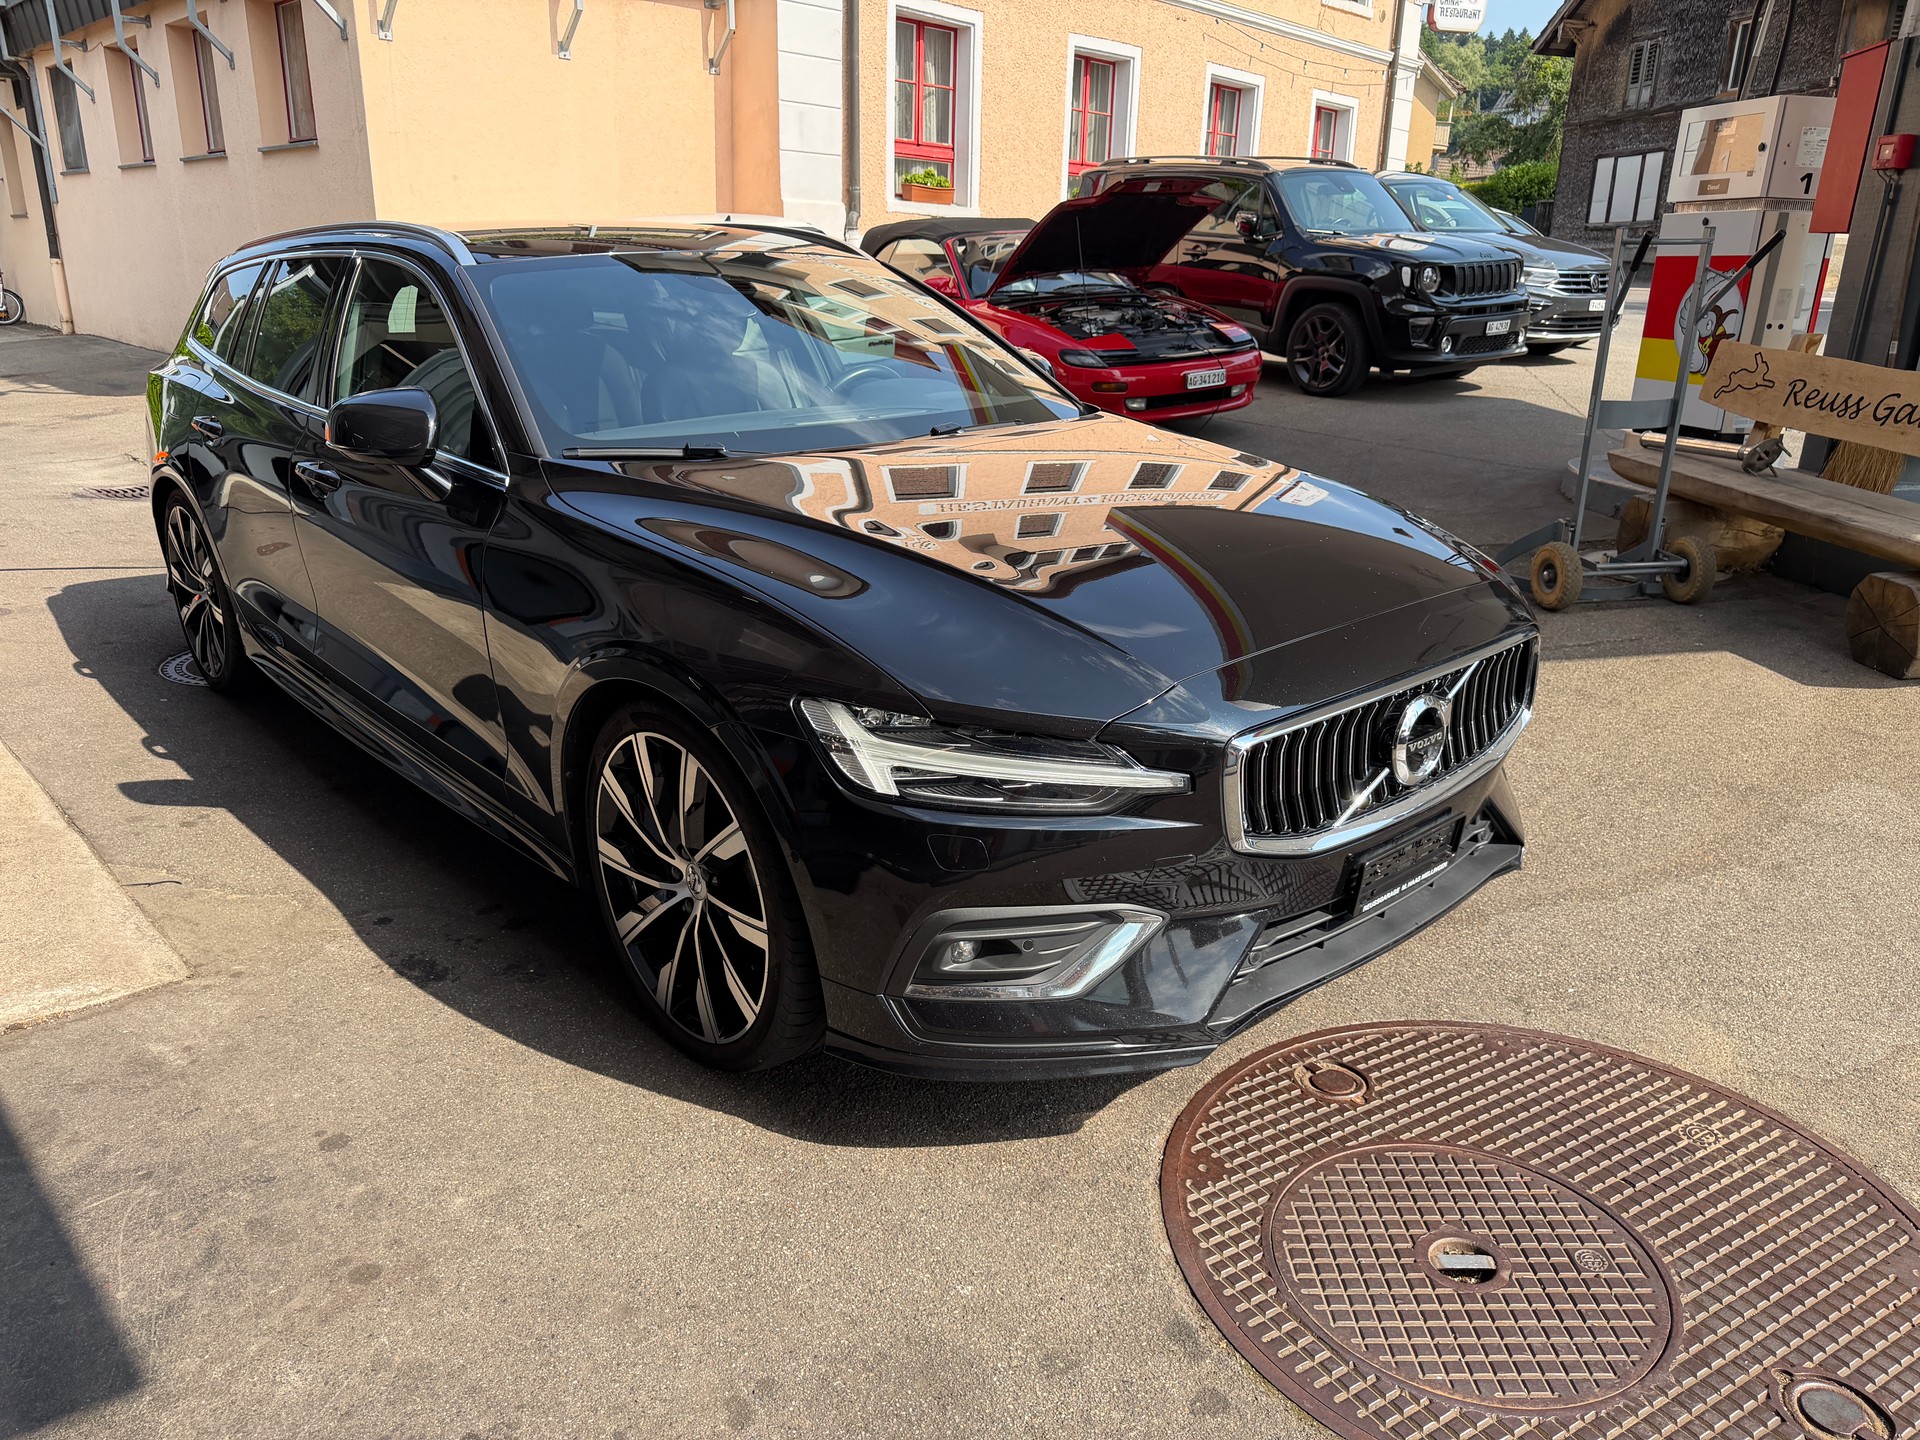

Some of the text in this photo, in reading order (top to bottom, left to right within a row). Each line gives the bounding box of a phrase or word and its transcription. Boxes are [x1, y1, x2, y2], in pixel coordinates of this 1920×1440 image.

[1800, 172, 1814, 195] 1
[1783, 379, 1920, 428] Reuss Ga
[1408, 731, 1443, 752] VOLVO
